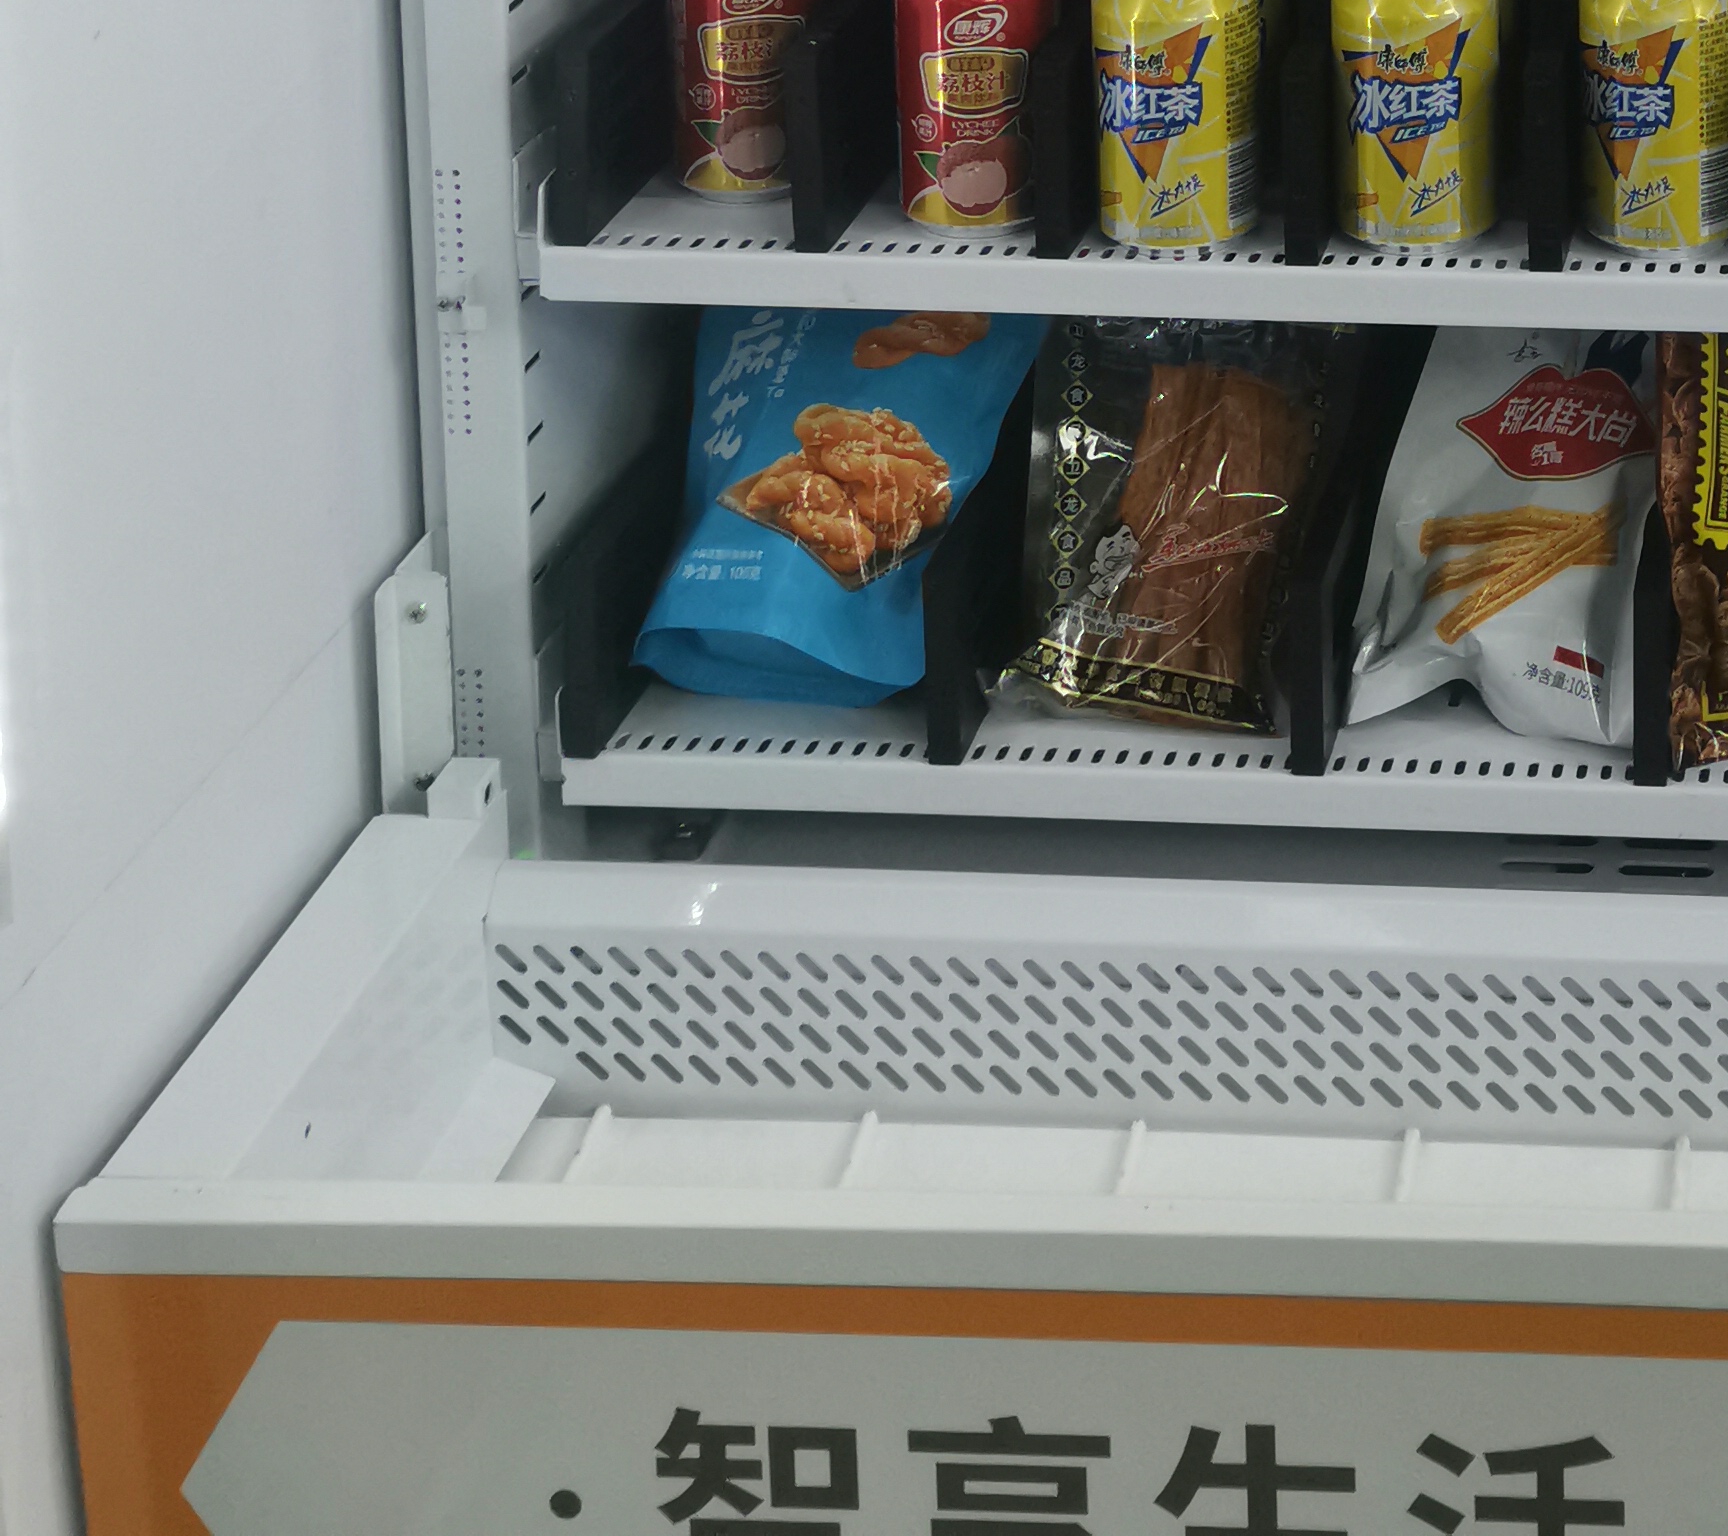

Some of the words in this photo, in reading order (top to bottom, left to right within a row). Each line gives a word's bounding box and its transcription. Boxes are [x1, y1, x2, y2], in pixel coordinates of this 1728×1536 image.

[1099, 80, 1201, 130] 冰红茶
[1355, 78, 1460, 130] 冰红茶
[1134, 127, 1165, 143] ICE
[1394, 127, 1427, 141] ICE
